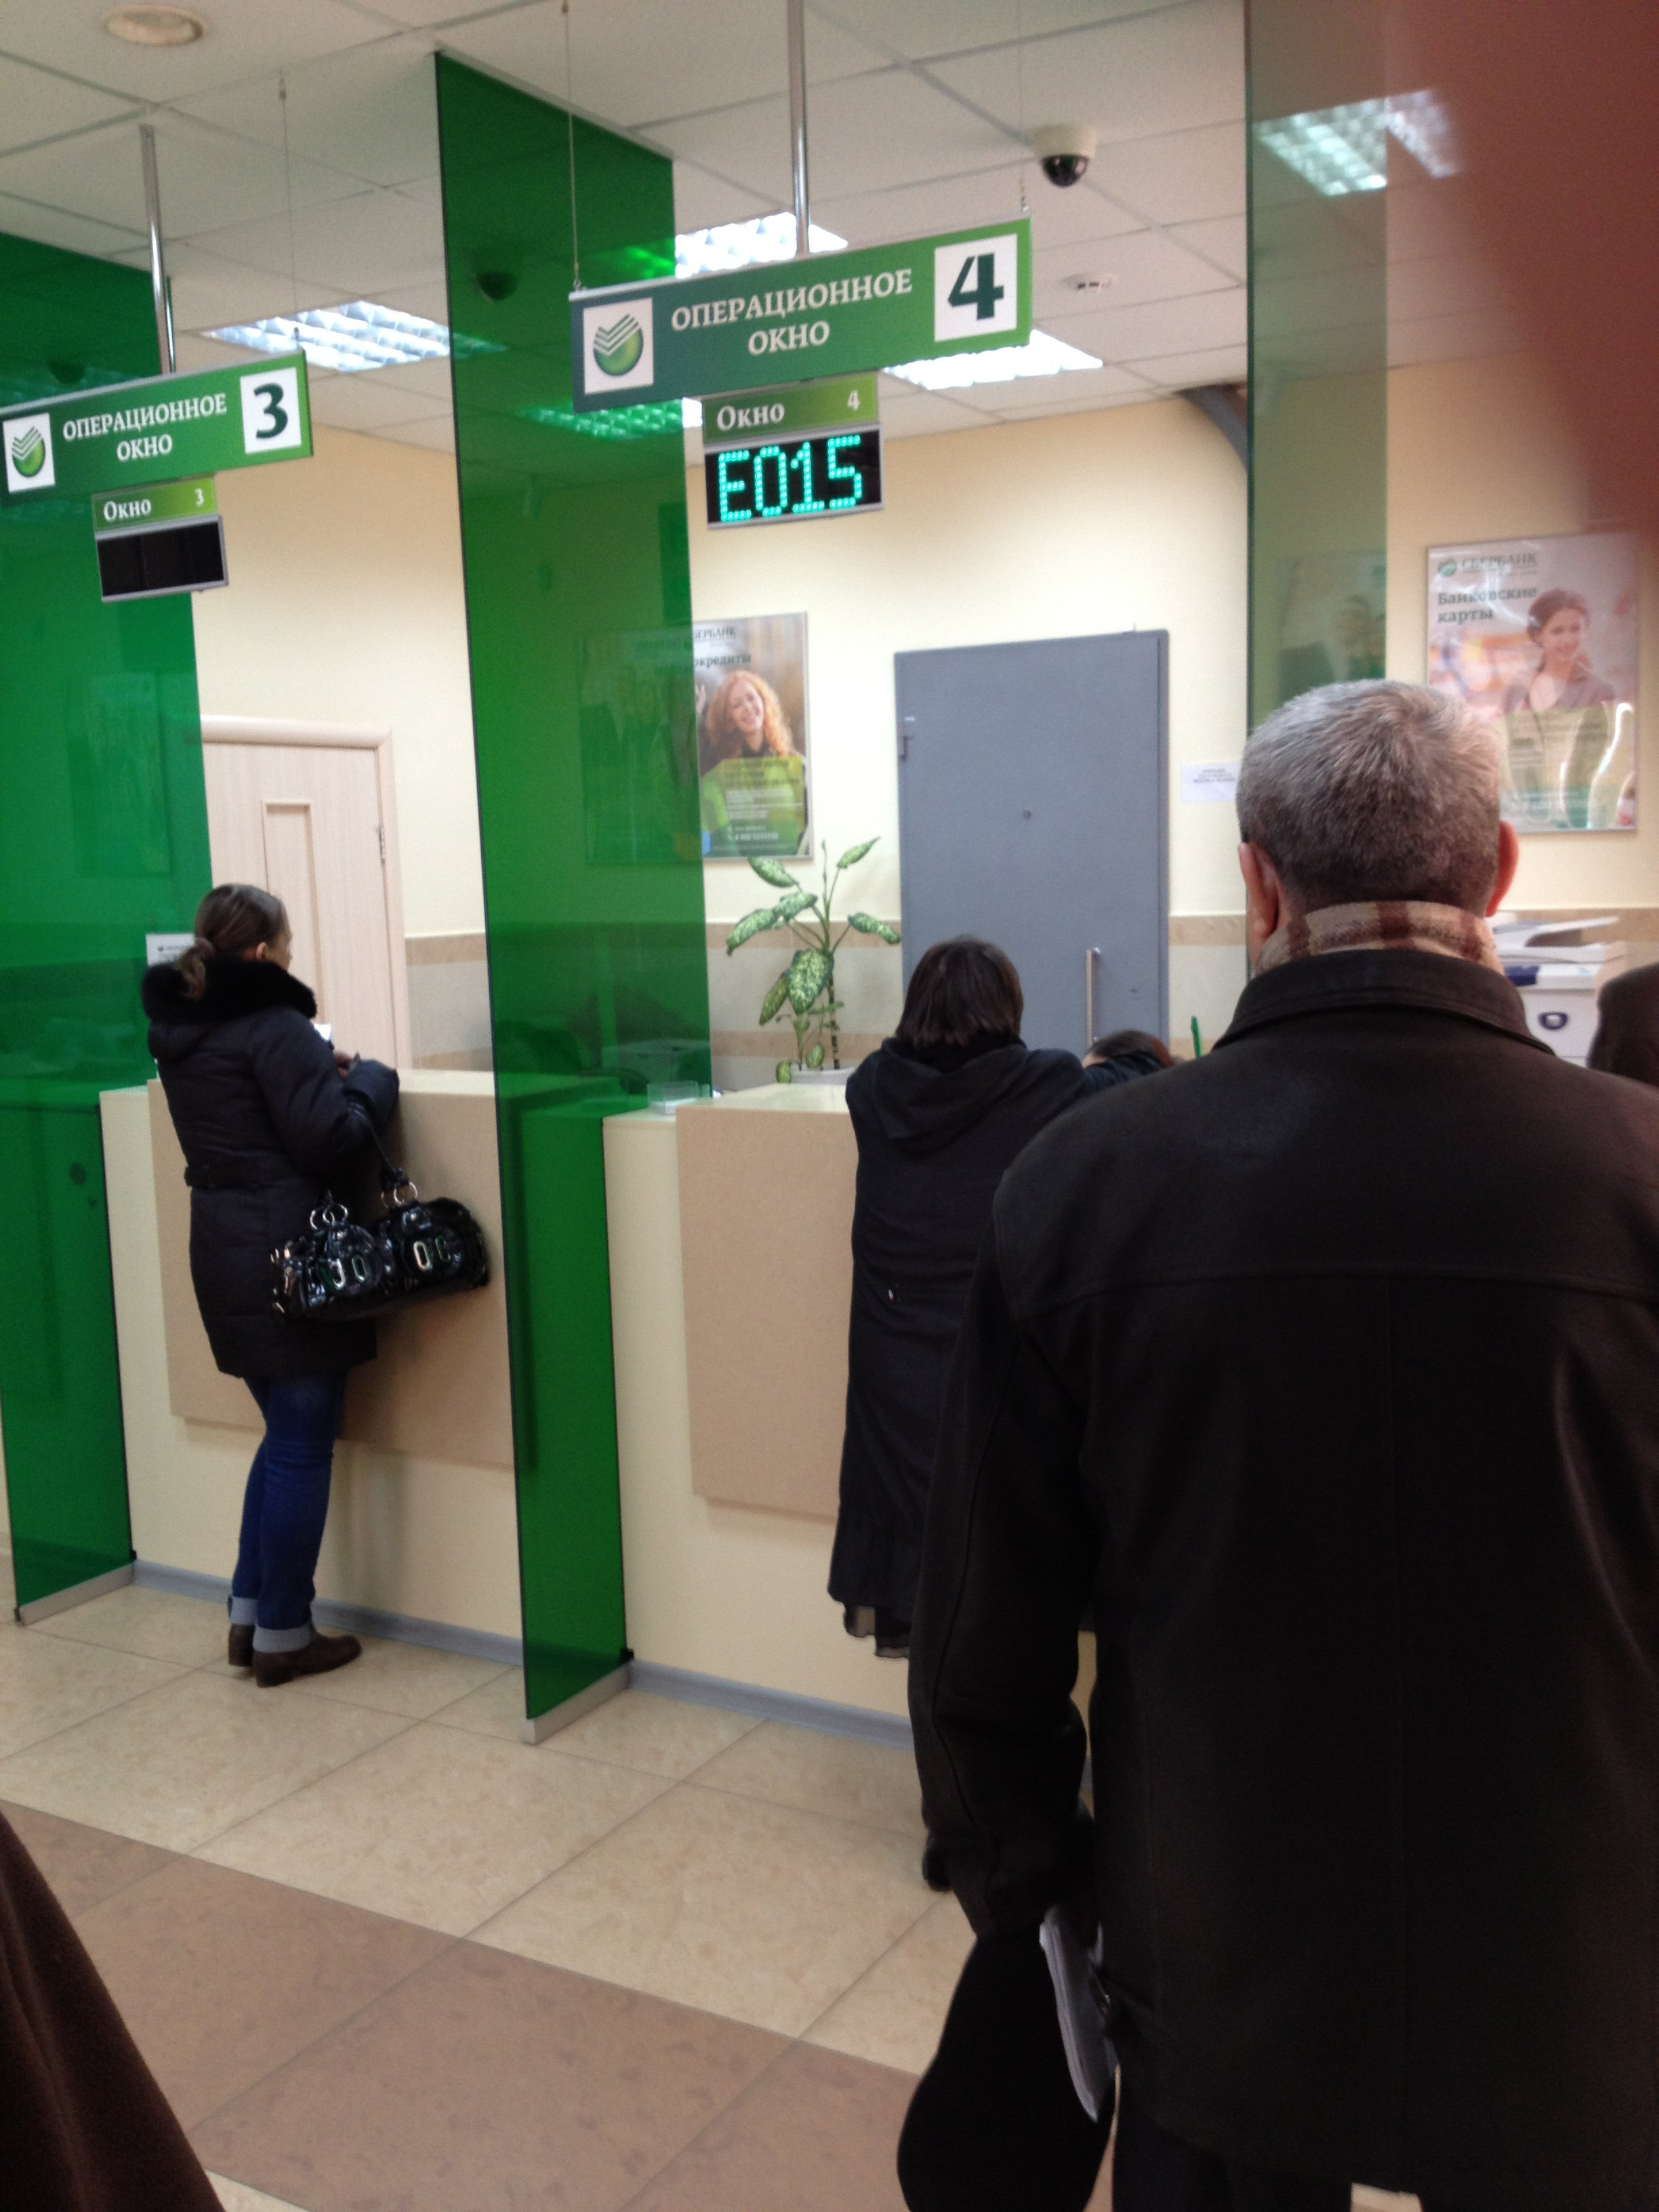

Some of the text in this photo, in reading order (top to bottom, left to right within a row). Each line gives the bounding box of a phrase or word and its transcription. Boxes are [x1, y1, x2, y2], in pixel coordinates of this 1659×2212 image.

[671, 269, 913, 331] ОПЕРАЦИОННОЕ
[948, 253, 1004, 321] 4
[748, 321, 830, 356] ОКНО
[63, 393, 227, 441] ОПЕРАЦИОННОЕ
[253, 382, 289, 439] 3
[716, 390, 860, 432] Окно 4
[117, 434, 173, 462] ОКНО
[103, 488, 204, 522] Окно 3
[1438, 588, 1538, 605] Банковские
[1438, 609, 1494, 624] карты
